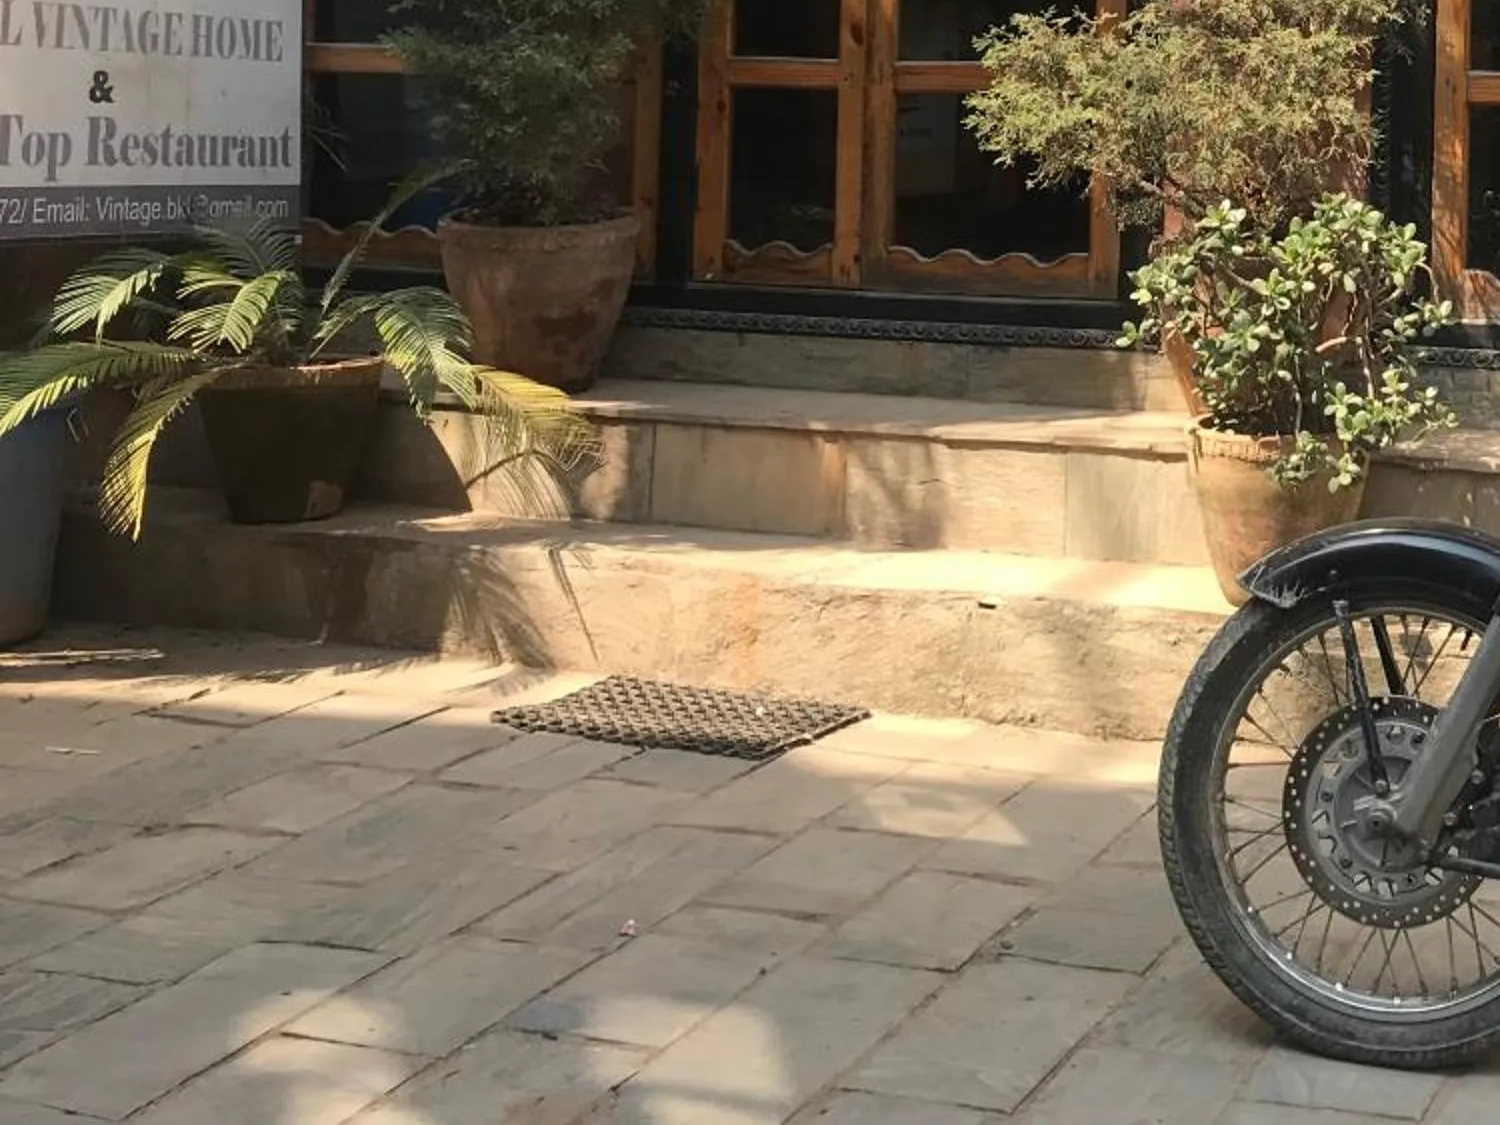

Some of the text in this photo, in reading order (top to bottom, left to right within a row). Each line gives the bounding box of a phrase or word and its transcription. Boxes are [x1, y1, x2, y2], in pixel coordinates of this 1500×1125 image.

[33, 1, 183, 56] VINTAGE
[191, 13, 283, 62] HOME
[88, 70, 114, 104] &
[85, 116, 293, 168] Restaurant
[33, 194, 90, 224] Email:
